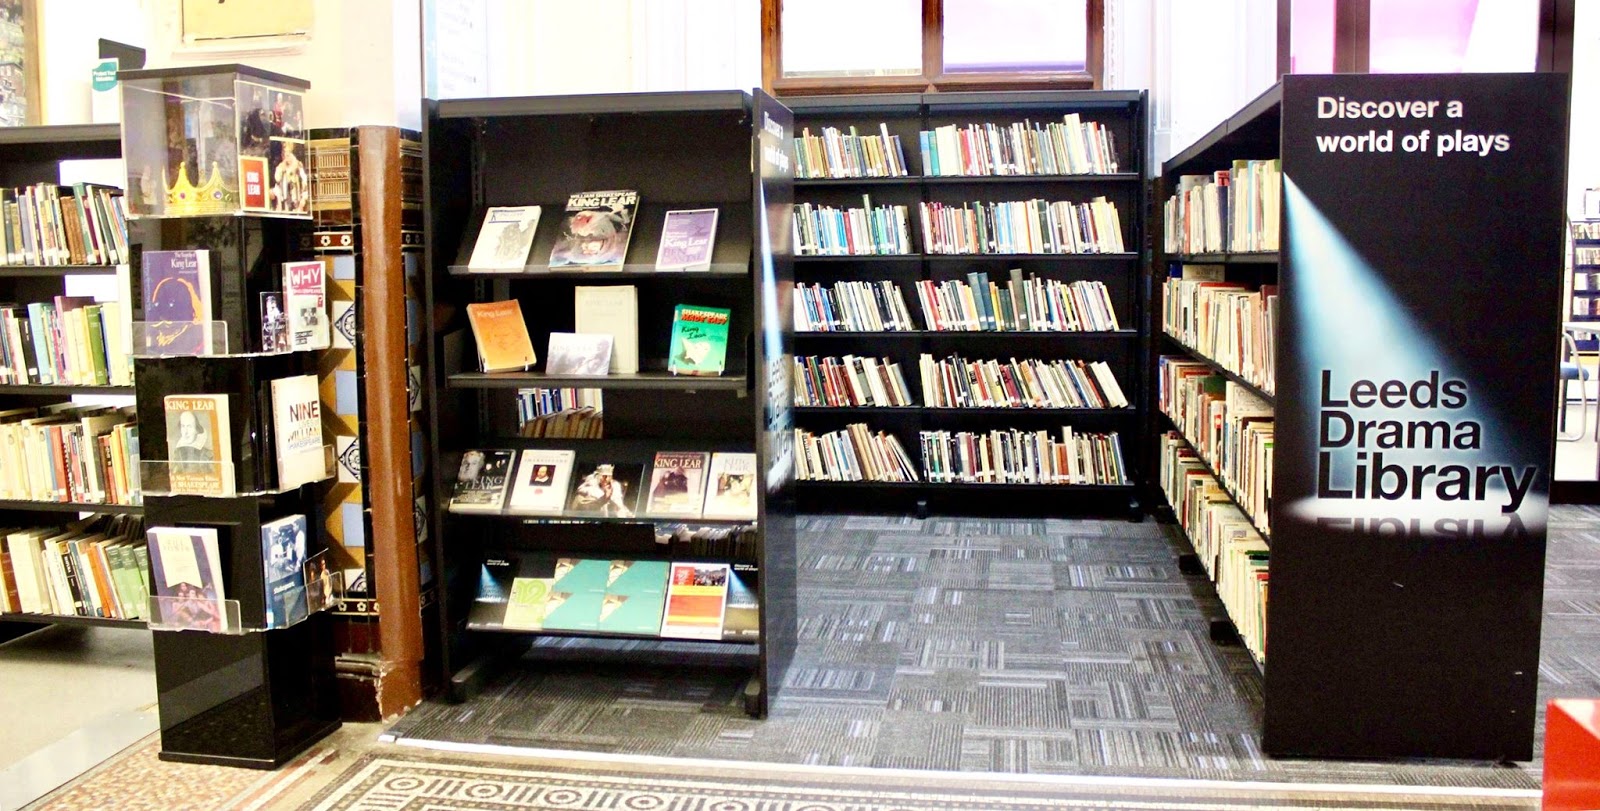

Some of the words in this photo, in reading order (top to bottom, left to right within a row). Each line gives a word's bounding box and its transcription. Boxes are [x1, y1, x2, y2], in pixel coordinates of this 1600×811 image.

[1317, 96, 1440, 119] Discover
[1446, 100, 1464, 118] a
[1316, 130, 1394, 153] world
[1401, 130, 1431, 152] of
[1437, 129, 1511, 157] plays
[568, 198, 600, 207] KING
[600, 196, 637, 206] LEAR
[664, 238, 687, 249] King
[688, 237, 709, 246] Lear
[171, 258, 185, 269] King
[185, 258, 197, 268] Lear
[290, 267, 321, 286] WHY
[681, 314, 705, 323] MADE
[1321, 370, 1467, 409] Leeds
[165, 400, 190, 410] KING
[192, 400, 215, 411] LEAR
[289, 400, 319, 423] NINE
[1320, 410, 1481, 450] Drama
[654, 458, 678, 468] KING
[680, 459, 702, 468] LEAR
[1318, 452, 1536, 513] Library
